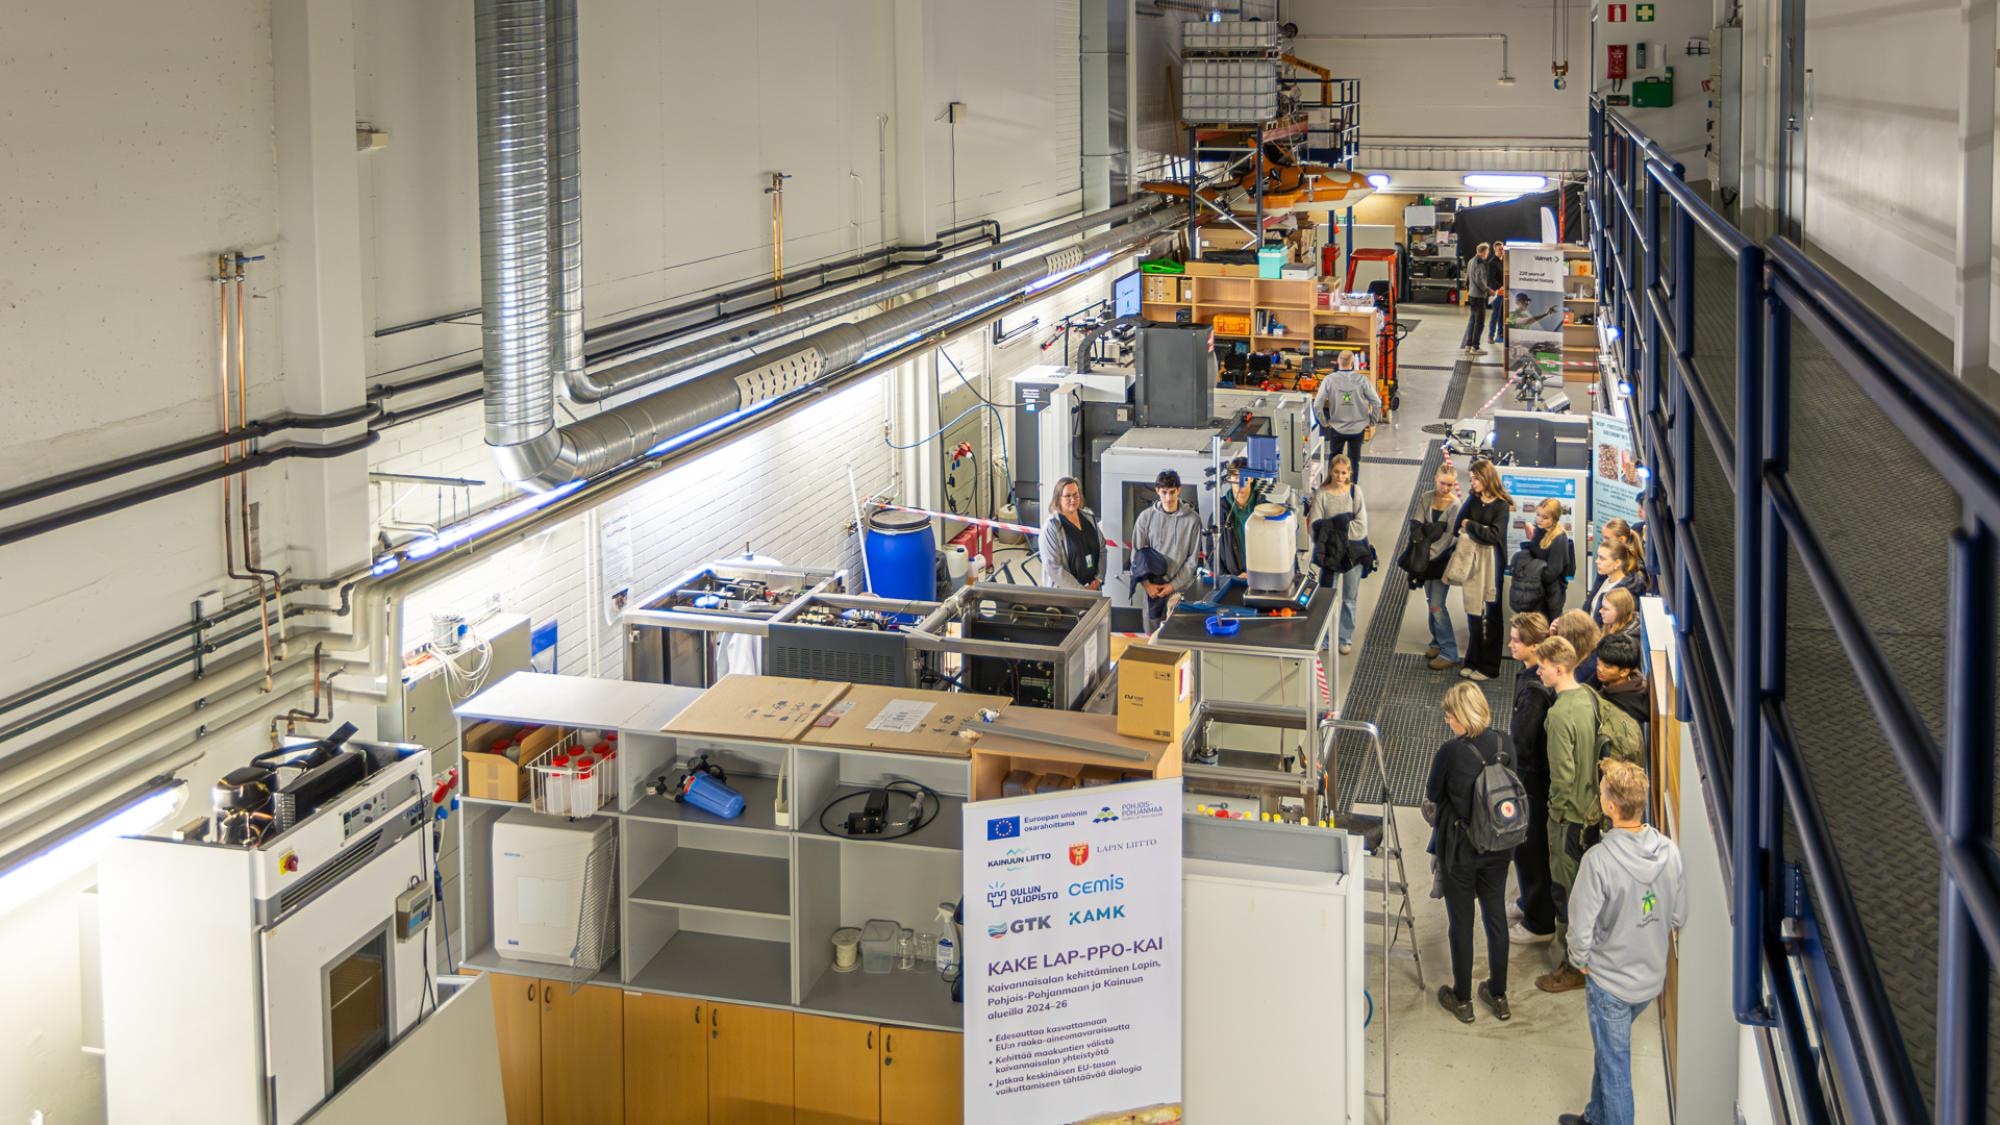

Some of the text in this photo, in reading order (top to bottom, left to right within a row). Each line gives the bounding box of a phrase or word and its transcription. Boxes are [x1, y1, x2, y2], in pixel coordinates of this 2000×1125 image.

[1024, 810, 1088, 823] Euroopan unionin
[1122, 806, 1163, 816] POHJANMAA
[1024, 820, 1075, 832] osarahoittama
[1096, 838, 1157, 853] LAPIN LIITTO
[987, 852, 1051, 868] KAINUUN LIITTO
[1010, 885, 1041, 897] OULUN
[1010, 891, 1058, 905] YLIOPISTO
[1010, 915, 1052, 934] GTK
[1069, 905, 1125, 925] KAMK
[988, 937, 1163, 976] KAKE LAP-PPO-KAI
[988, 958, 1161, 993] Kaivannaisalan kehittäminen Lapin,
[988, 974, 1143, 1007] Pohjois-Pohjanmaan ja Kainuun
[988, 1005, 1023, 1020] alueilla
[995, 1017, 1107, 1042] Edesauttaa kasvattamaan
[995, 1023, 1130, 1052] EU:n raaka-aineomavaraisuutta
[995, 1037, 1114, 1064] Kehittää maakuntien välistä
[995, 1048, 1109, 1074] kaivannaisalan yhteistyötä
[995, 1059, 1116, 1088] Jatkaa keskinäisen EU-tason
[995, 1064, 1142, 1096] vaikuttamiseen tähtäävää dialogia
